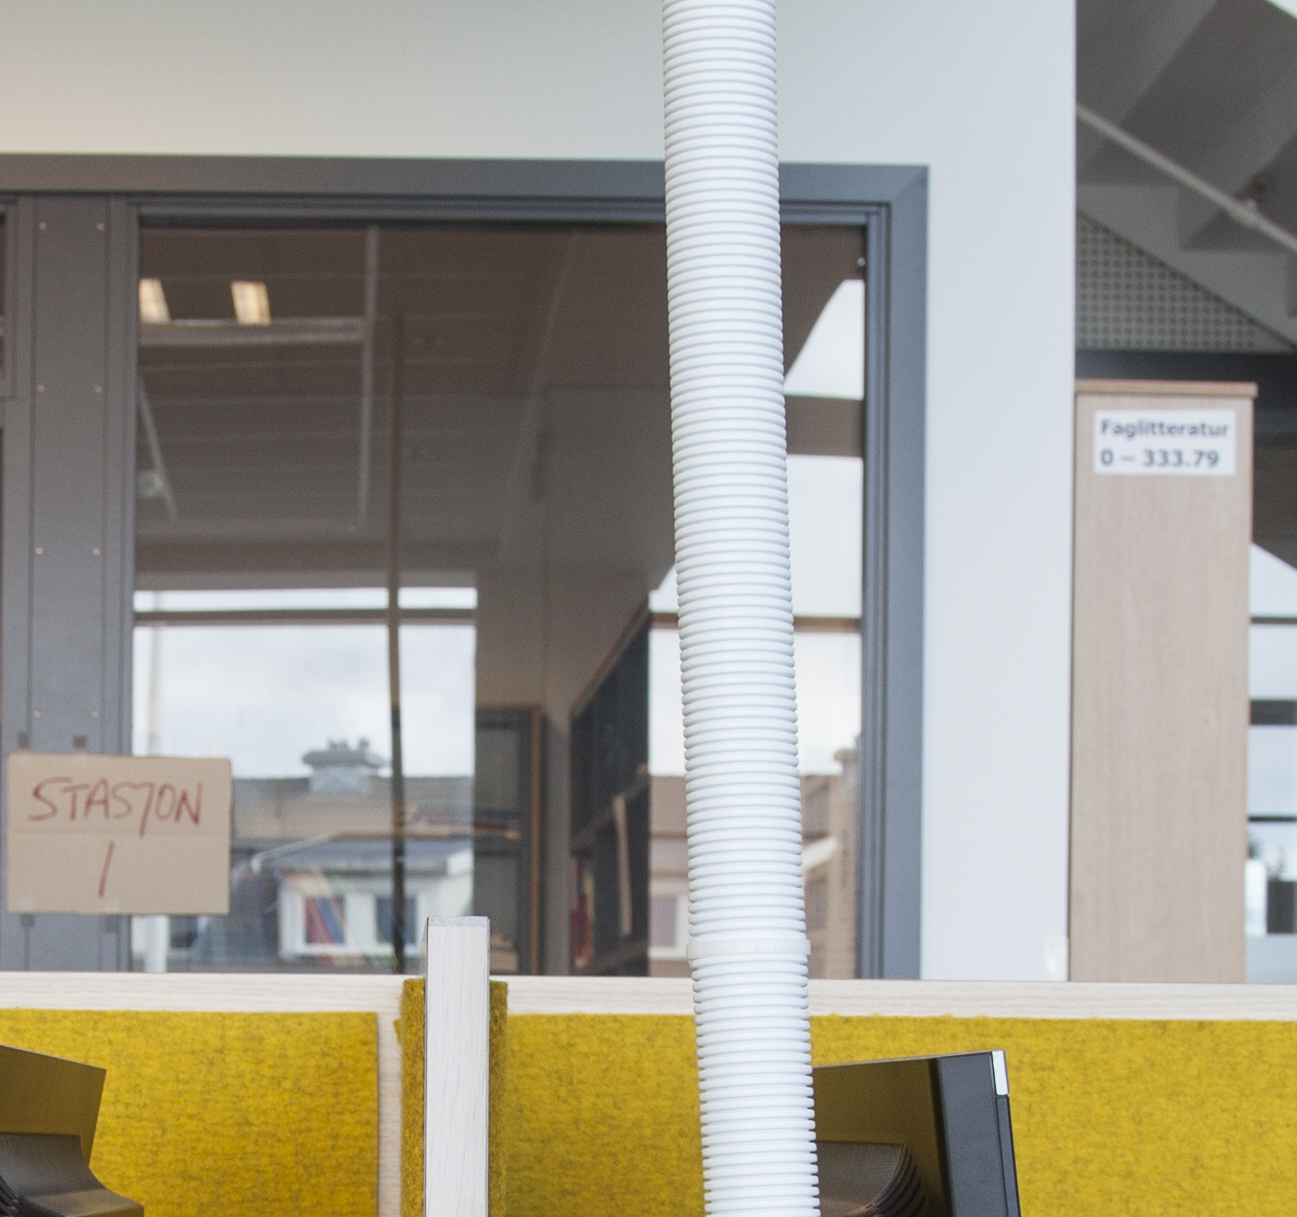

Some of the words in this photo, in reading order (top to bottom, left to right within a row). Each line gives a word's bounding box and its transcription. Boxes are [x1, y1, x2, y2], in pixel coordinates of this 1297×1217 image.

[1101, 420, 1230, 438] Faglitteratur
[1101, 450, 1113, 466] 0
[1143, 449, 1219, 466] 333.79
[27, 776, 203, 839] STASJON
